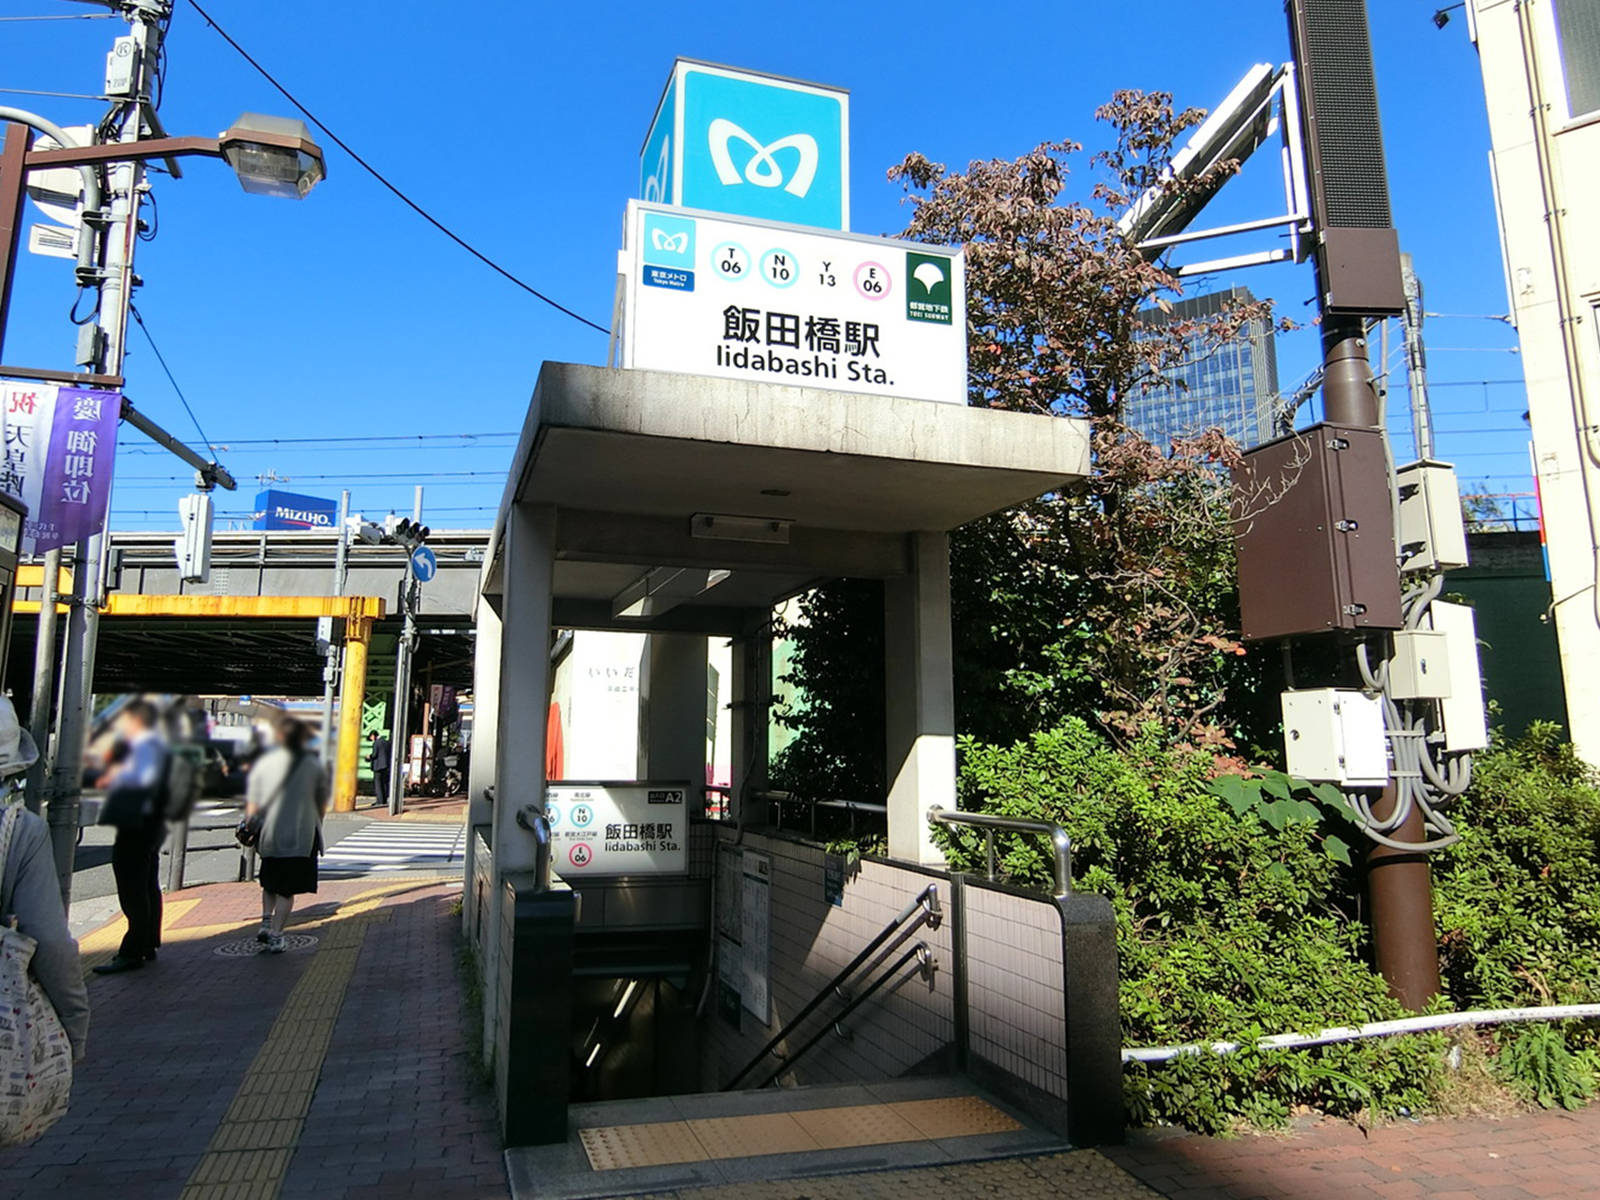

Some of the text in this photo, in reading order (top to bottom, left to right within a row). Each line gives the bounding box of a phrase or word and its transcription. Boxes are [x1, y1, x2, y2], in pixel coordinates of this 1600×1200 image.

[728, 248, 736, 260] T
[773, 254, 786, 267] N
[721, 260, 742, 274] 06
[772, 266, 790, 281] 10
[822, 261, 831, 273] Y
[869, 268, 876, 279] E
[819, 274, 836, 287] 13
[864, 280, 882, 294] 06
[722, 304, 880, 358] 飯田橋駅
[717, 344, 895, 386] Iidabashi Sta.
[665, 792, 682, 803] A2
[577, 814, 588, 823] 10
[604, 822, 673, 841] 飯田橋駅
[605, 841, 681, 852] Iidabashi Sta.
[574, 855, 587, 863] 06
